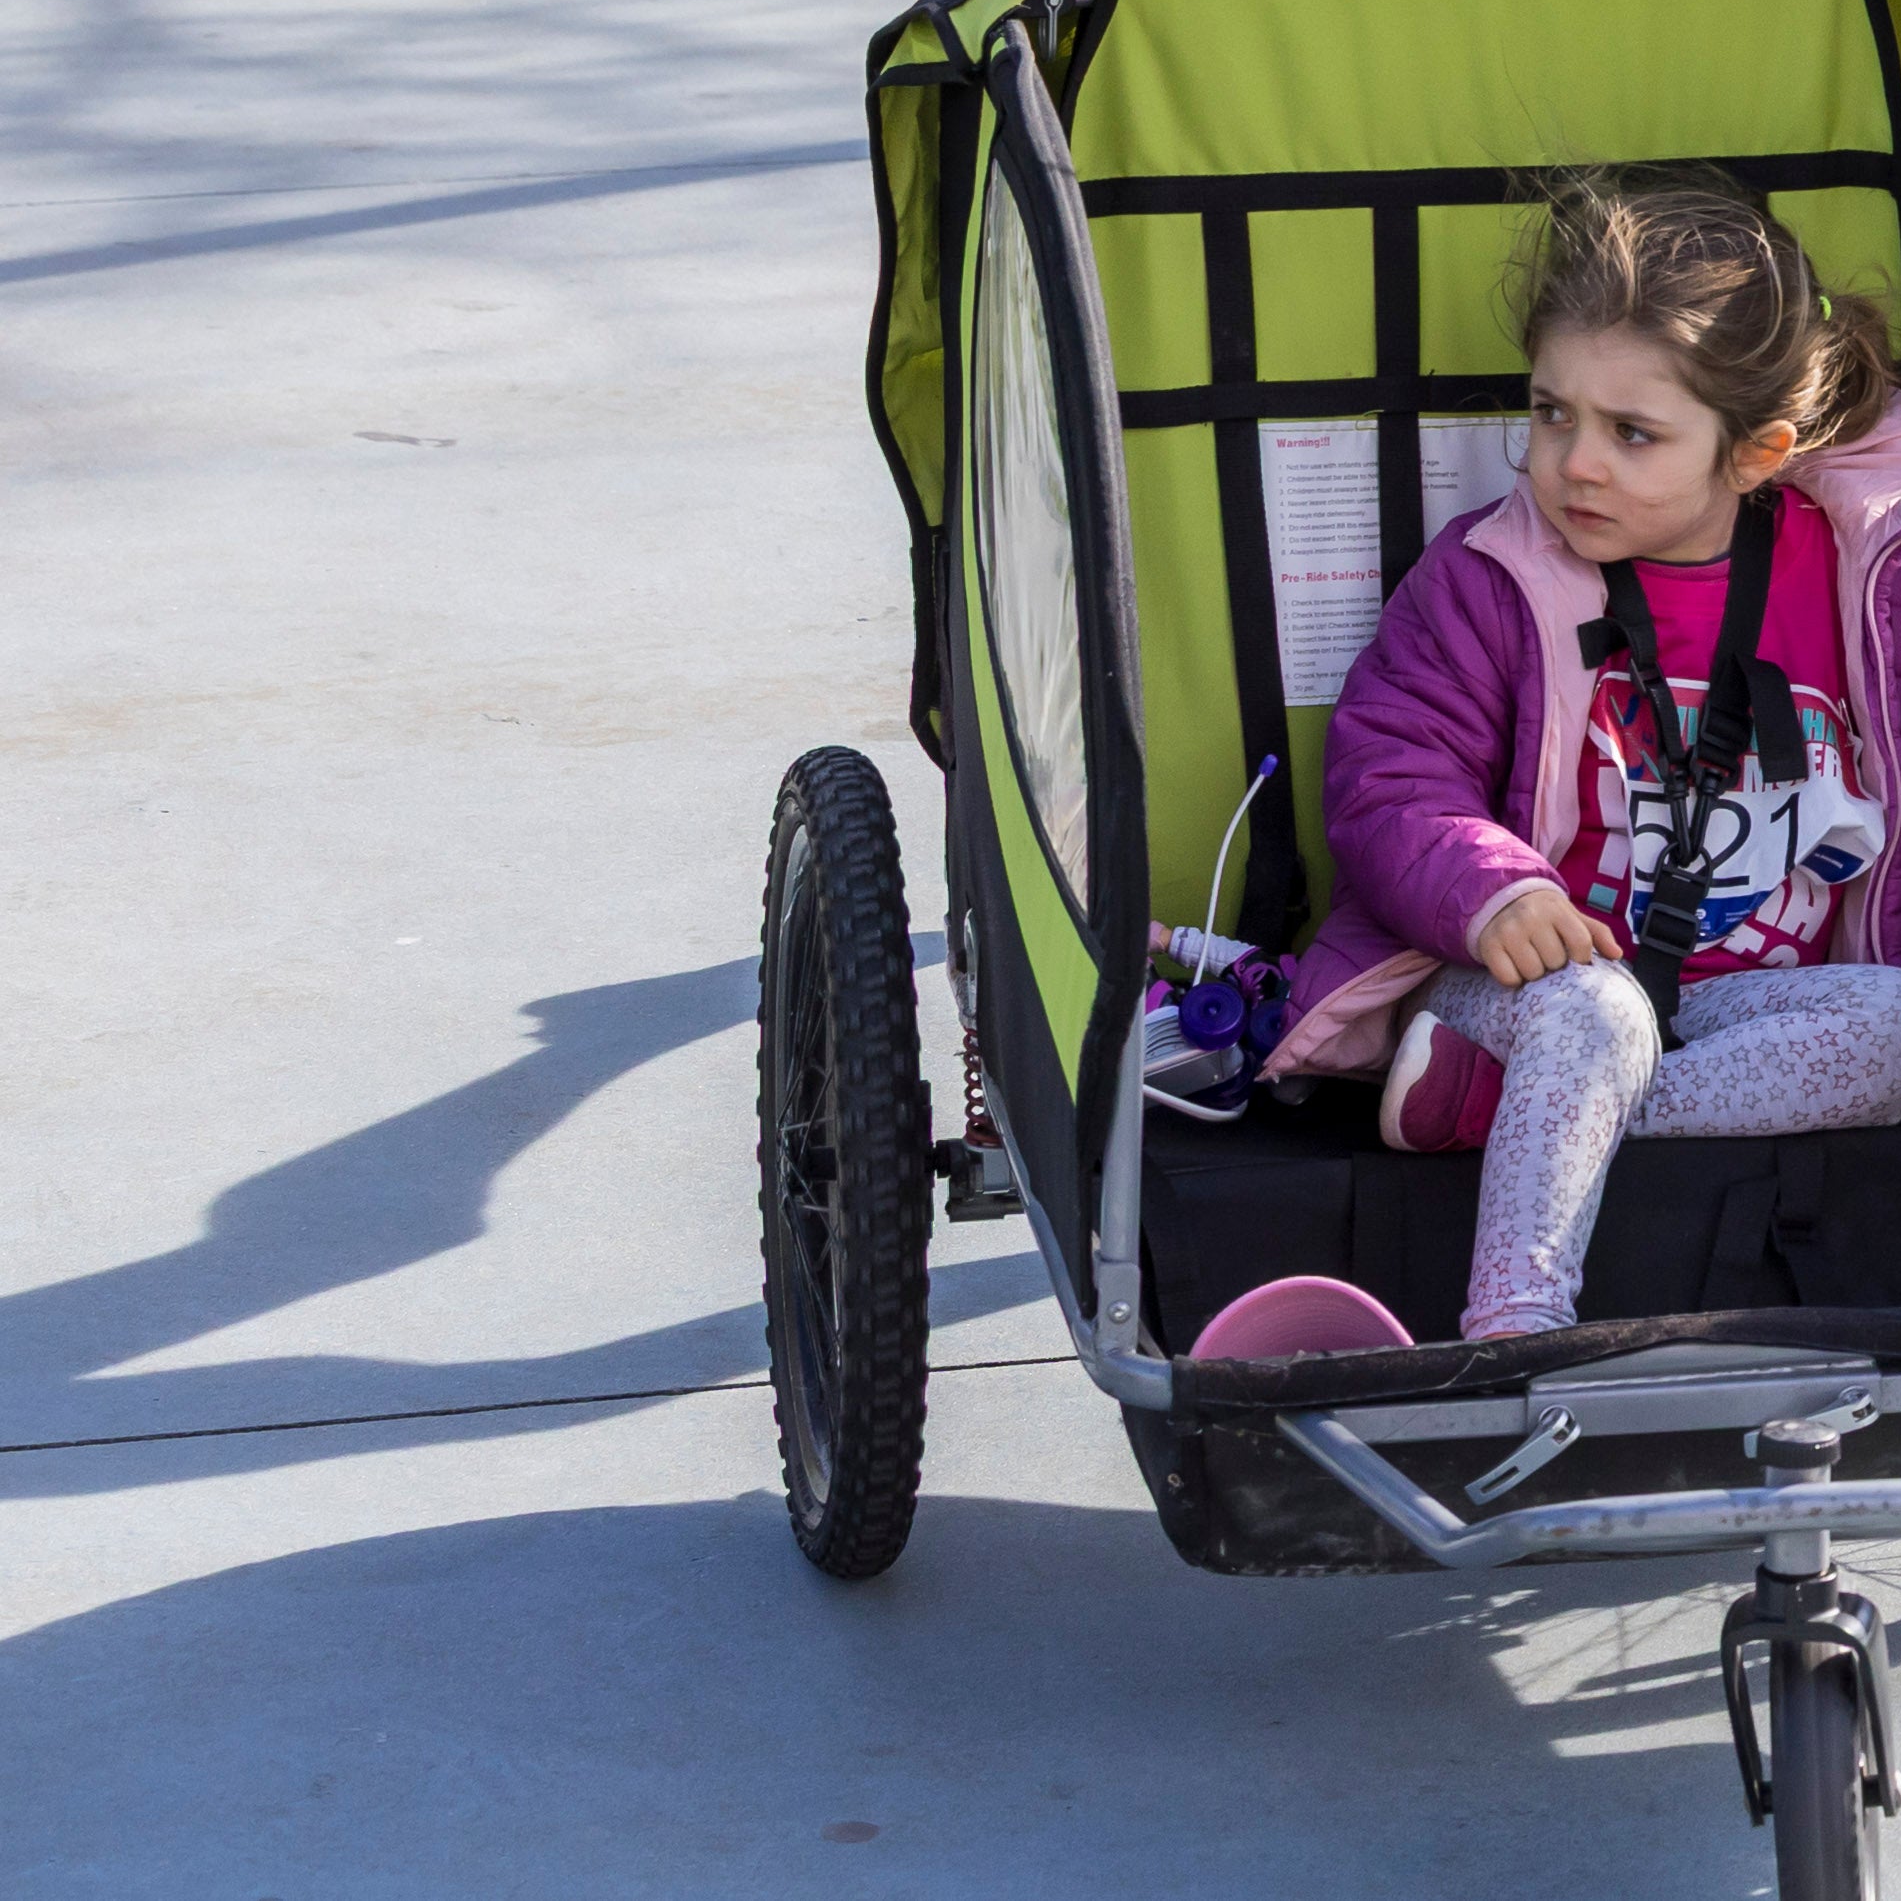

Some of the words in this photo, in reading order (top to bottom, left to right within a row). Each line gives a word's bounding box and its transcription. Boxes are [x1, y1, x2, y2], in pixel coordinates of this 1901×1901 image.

[1277, 437, 1330, 449] Warning!!!
[1281, 571, 1329, 583] Pre-Ride
[1331, 570, 1365, 582] Safety
[1630, 790, 1800, 888] 521
